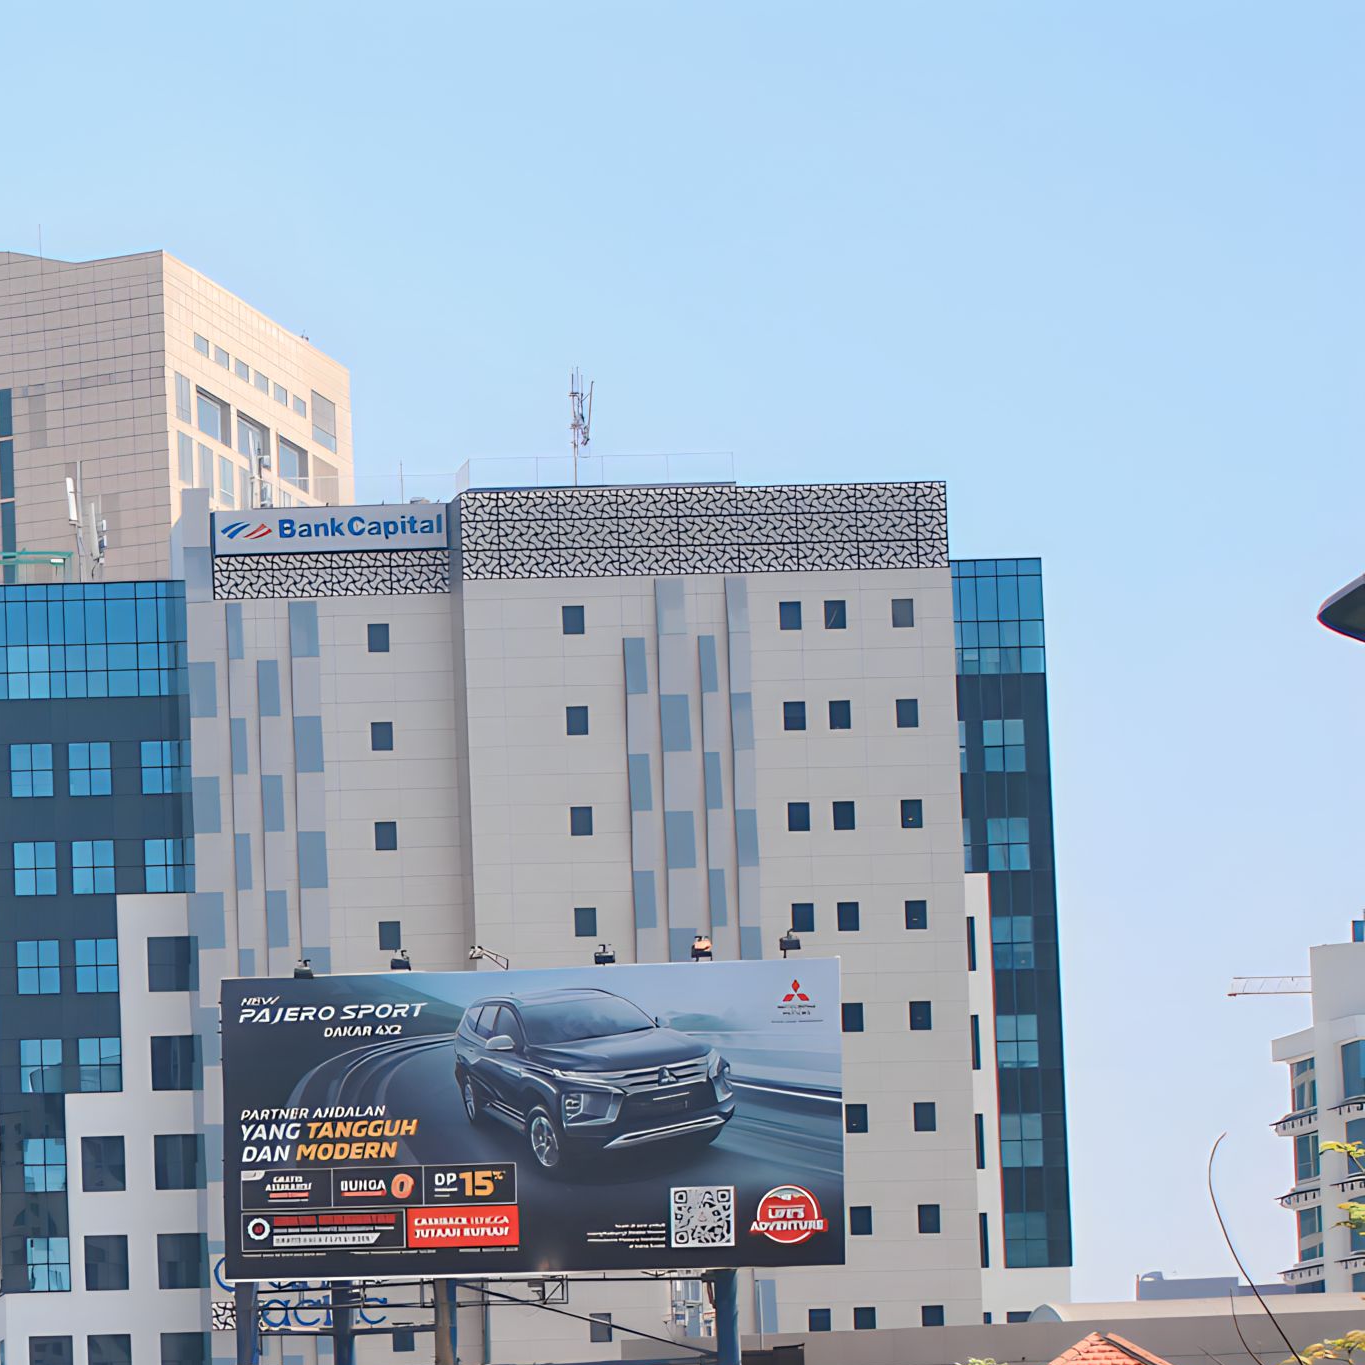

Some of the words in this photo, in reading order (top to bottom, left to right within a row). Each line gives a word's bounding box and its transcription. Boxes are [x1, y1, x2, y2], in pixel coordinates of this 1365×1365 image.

[239, 1006, 335, 1024] PAJERO
[340, 1002, 428, 1020] SPORT
[324, 1025, 372, 1037] DAKAR
[241, 1108, 309, 1121] PARTNER
[313, 1105, 385, 1119] ANDALAN
[241, 1123, 301, 1141] YANG
[307, 1119, 418, 1139] TANGGUH
[241, 1145, 291, 1162] DAN
[296, 1141, 398, 1161] MODERN
[340, 1180, 386, 1191] BUNGA
[434, 1173, 458, 1186] DP
